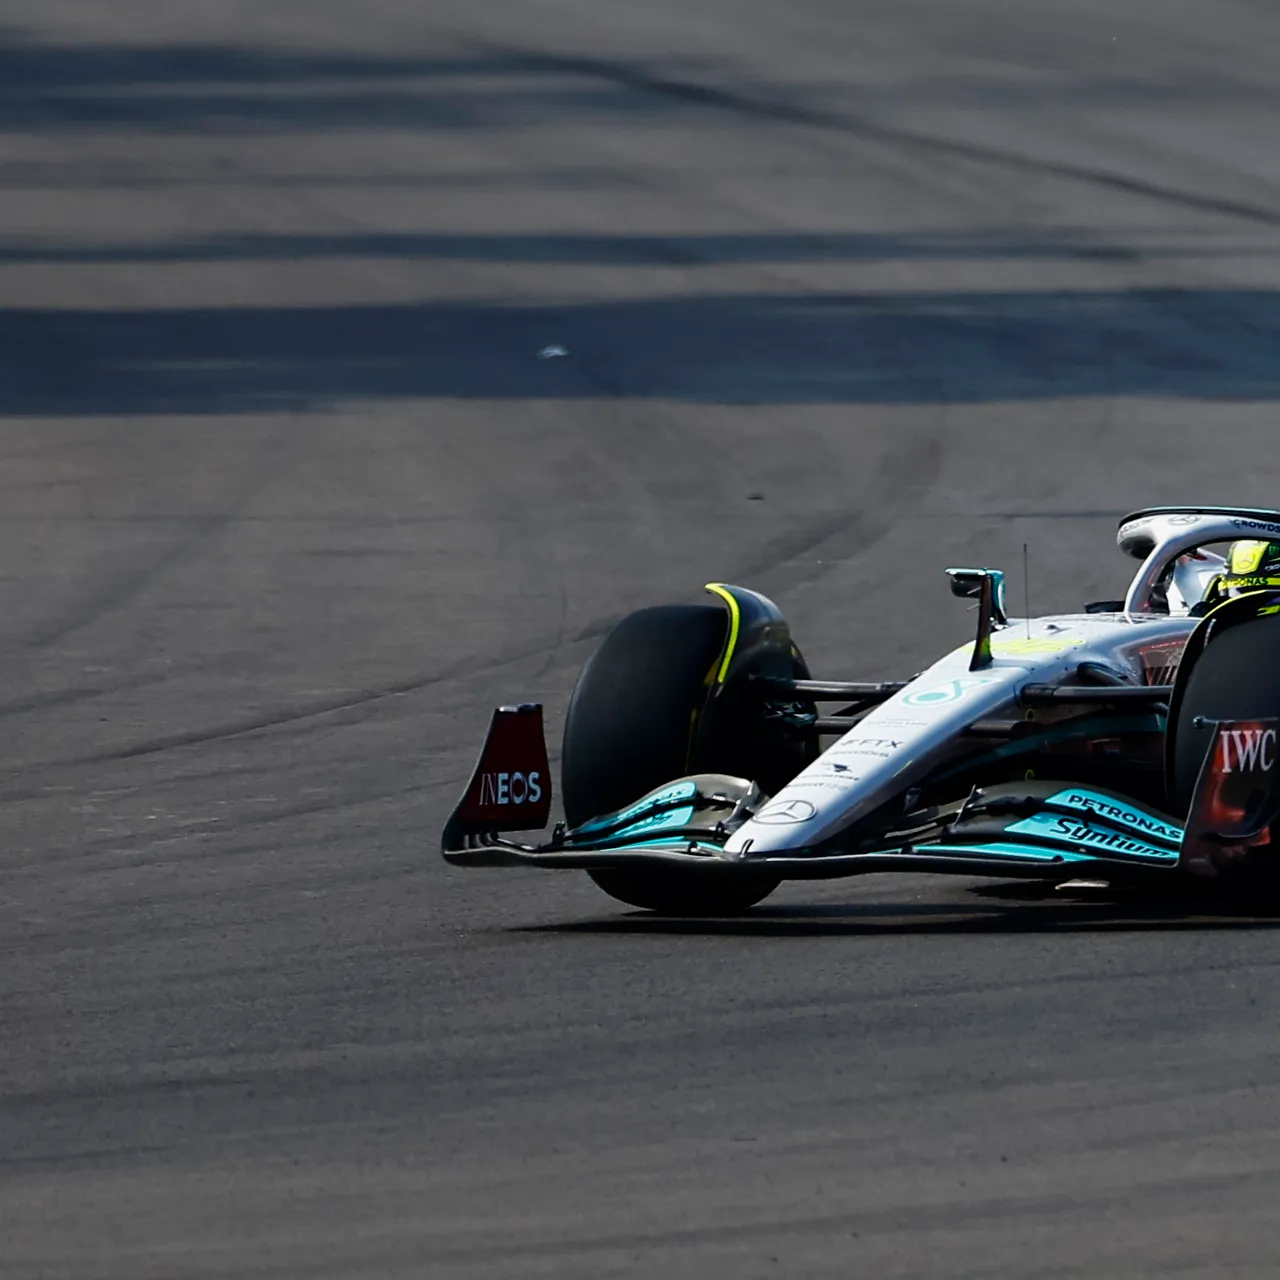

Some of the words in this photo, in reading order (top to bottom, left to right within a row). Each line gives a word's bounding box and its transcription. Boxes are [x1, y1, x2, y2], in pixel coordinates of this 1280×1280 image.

[1220, 730, 1276, 773] IWC
[479, 771, 542, 806] INEOS
[1050, 817, 1170, 857] Syntium
[1068, 794, 1182, 840] PETRONAS
